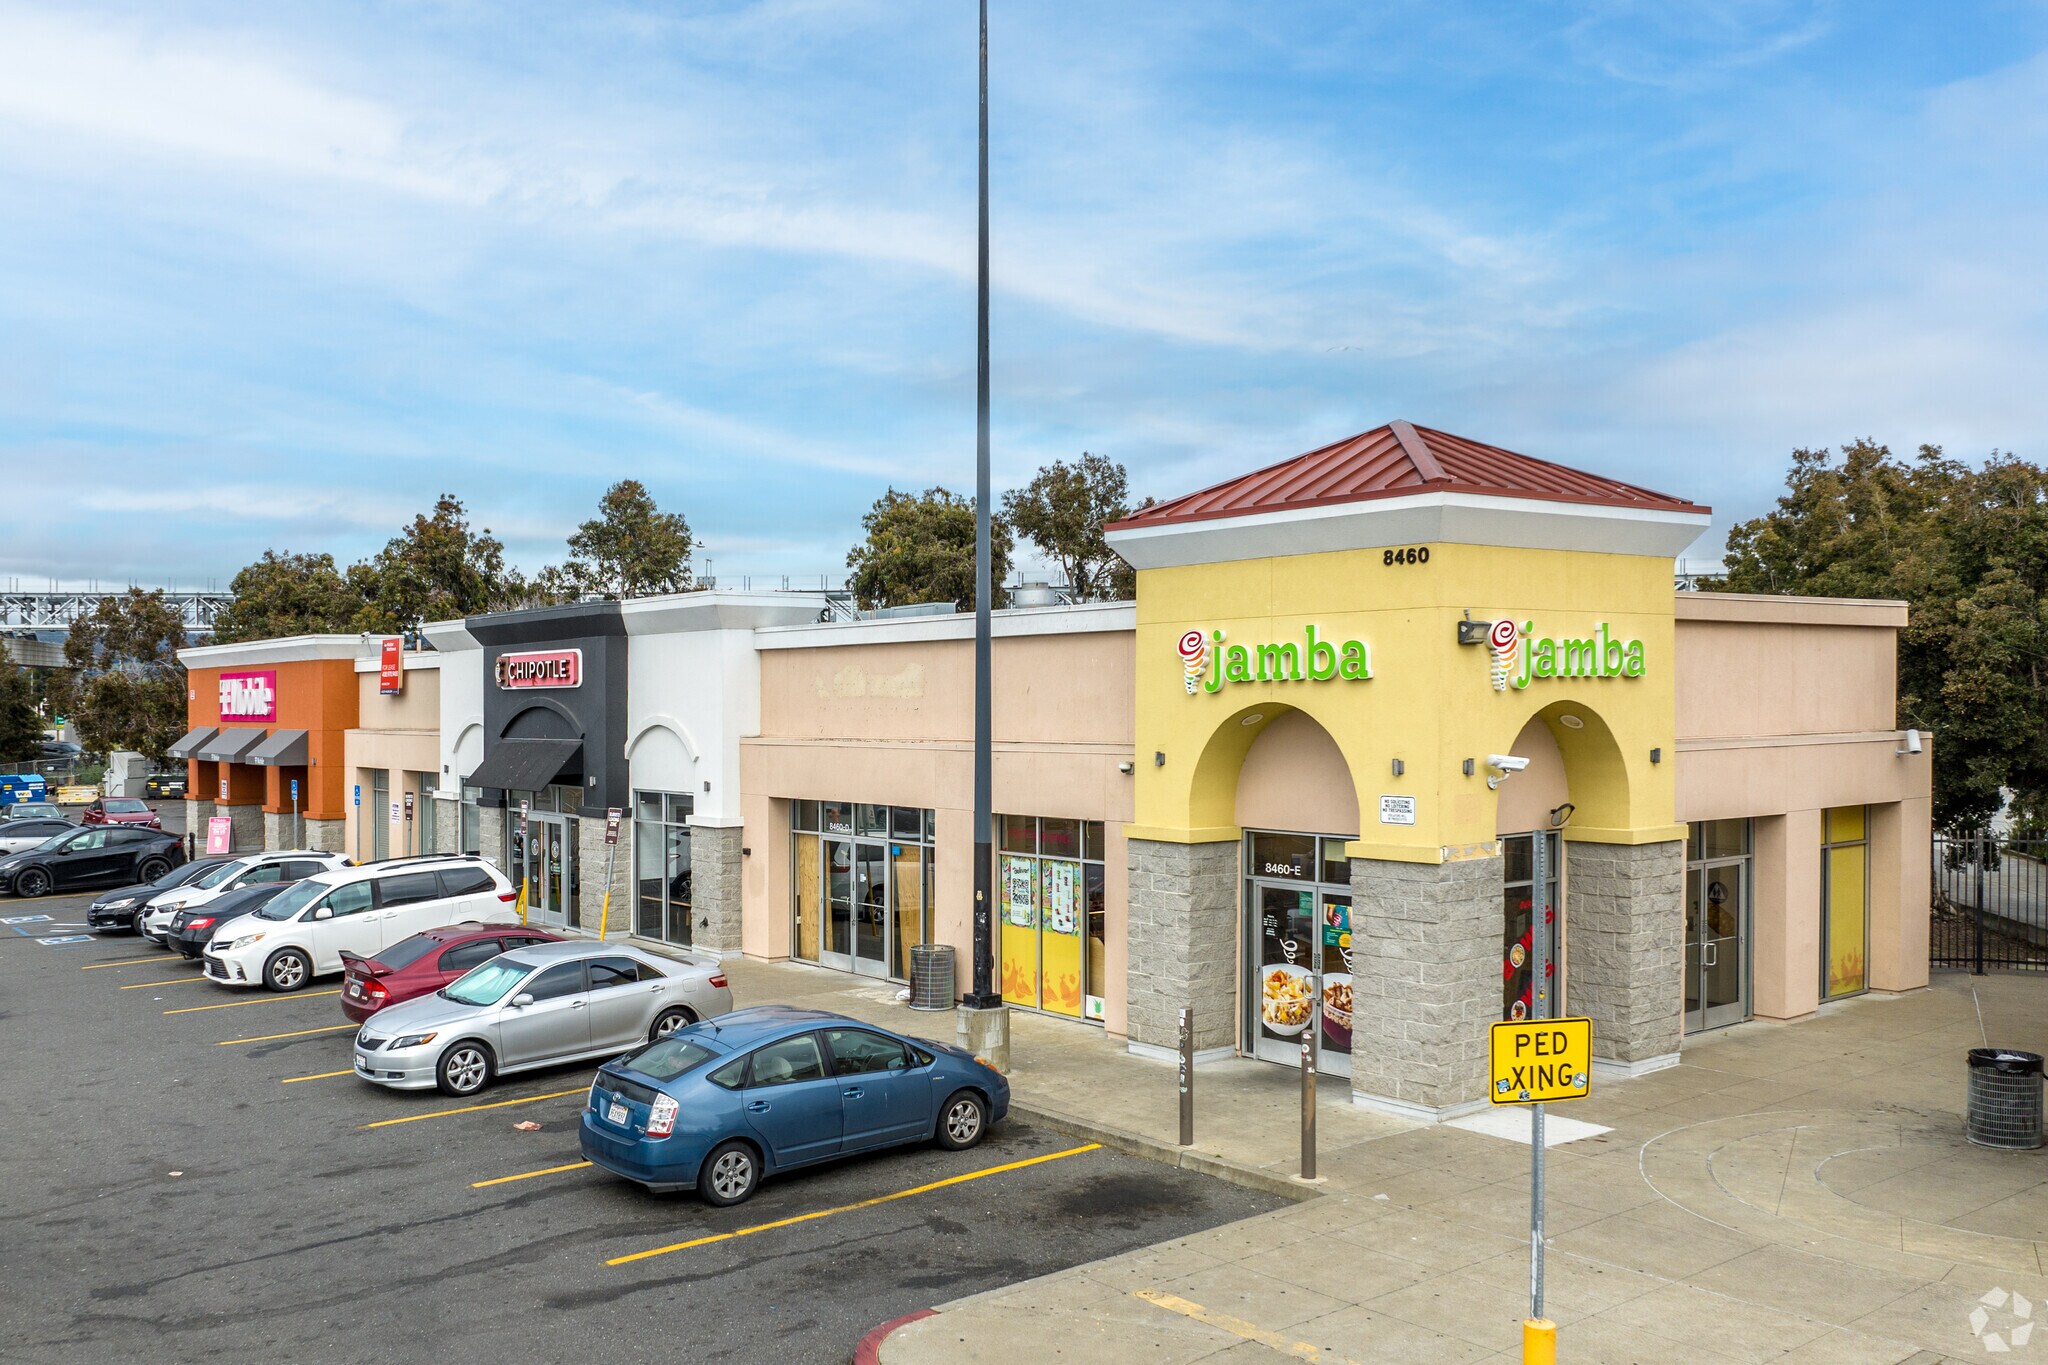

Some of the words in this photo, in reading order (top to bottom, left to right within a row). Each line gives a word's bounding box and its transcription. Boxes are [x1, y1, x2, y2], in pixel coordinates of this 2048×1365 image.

[1383, 546, 1430, 567] 8460
[1204, 624, 1372, 693] jamba
[1514, 620, 1647, 689] jamba
[508, 659, 567, 679] CHIPOTLE
[1265, 862, 1301, 876] 8460-E
[1515, 1031, 1568, 1058] PED
[1511, 1063, 1573, 1090] XING
